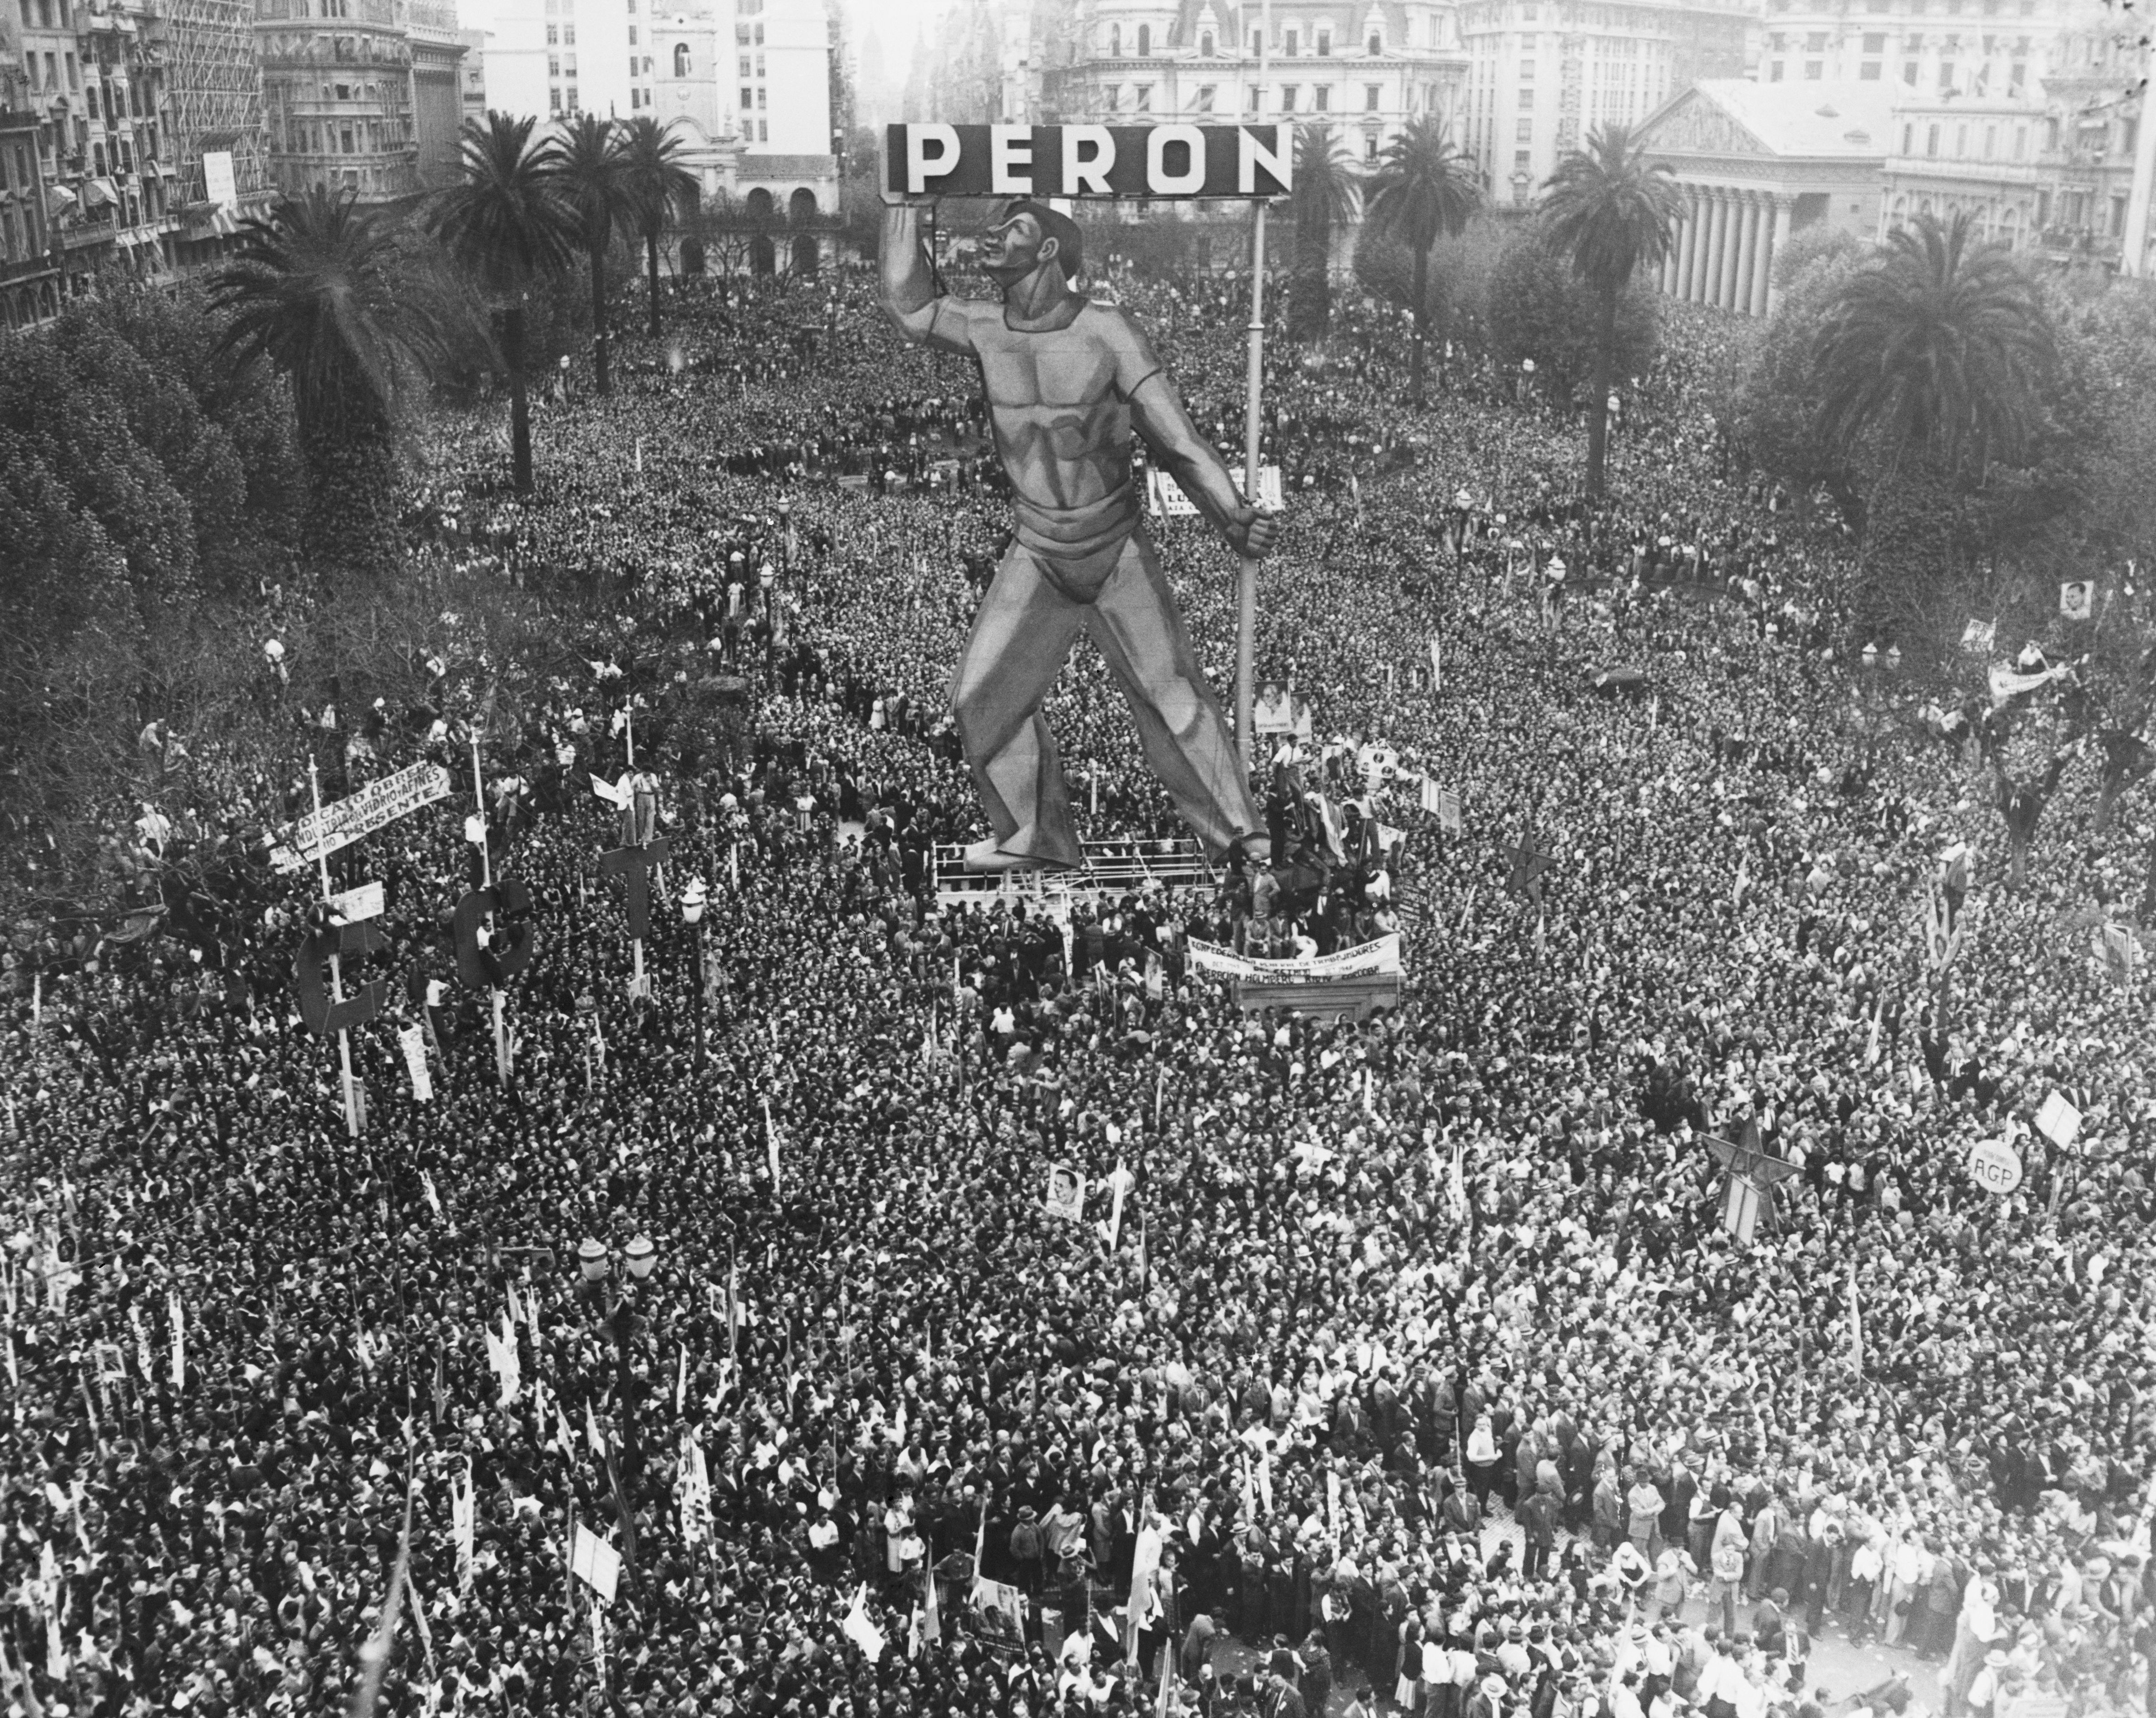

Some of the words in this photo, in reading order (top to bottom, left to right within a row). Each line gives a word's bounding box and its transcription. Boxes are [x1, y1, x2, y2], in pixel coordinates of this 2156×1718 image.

[906, 124, 1293, 193] PERON
[361, 790, 397, 815] VIDRIO
[402, 767, 440, 795] AFINES
